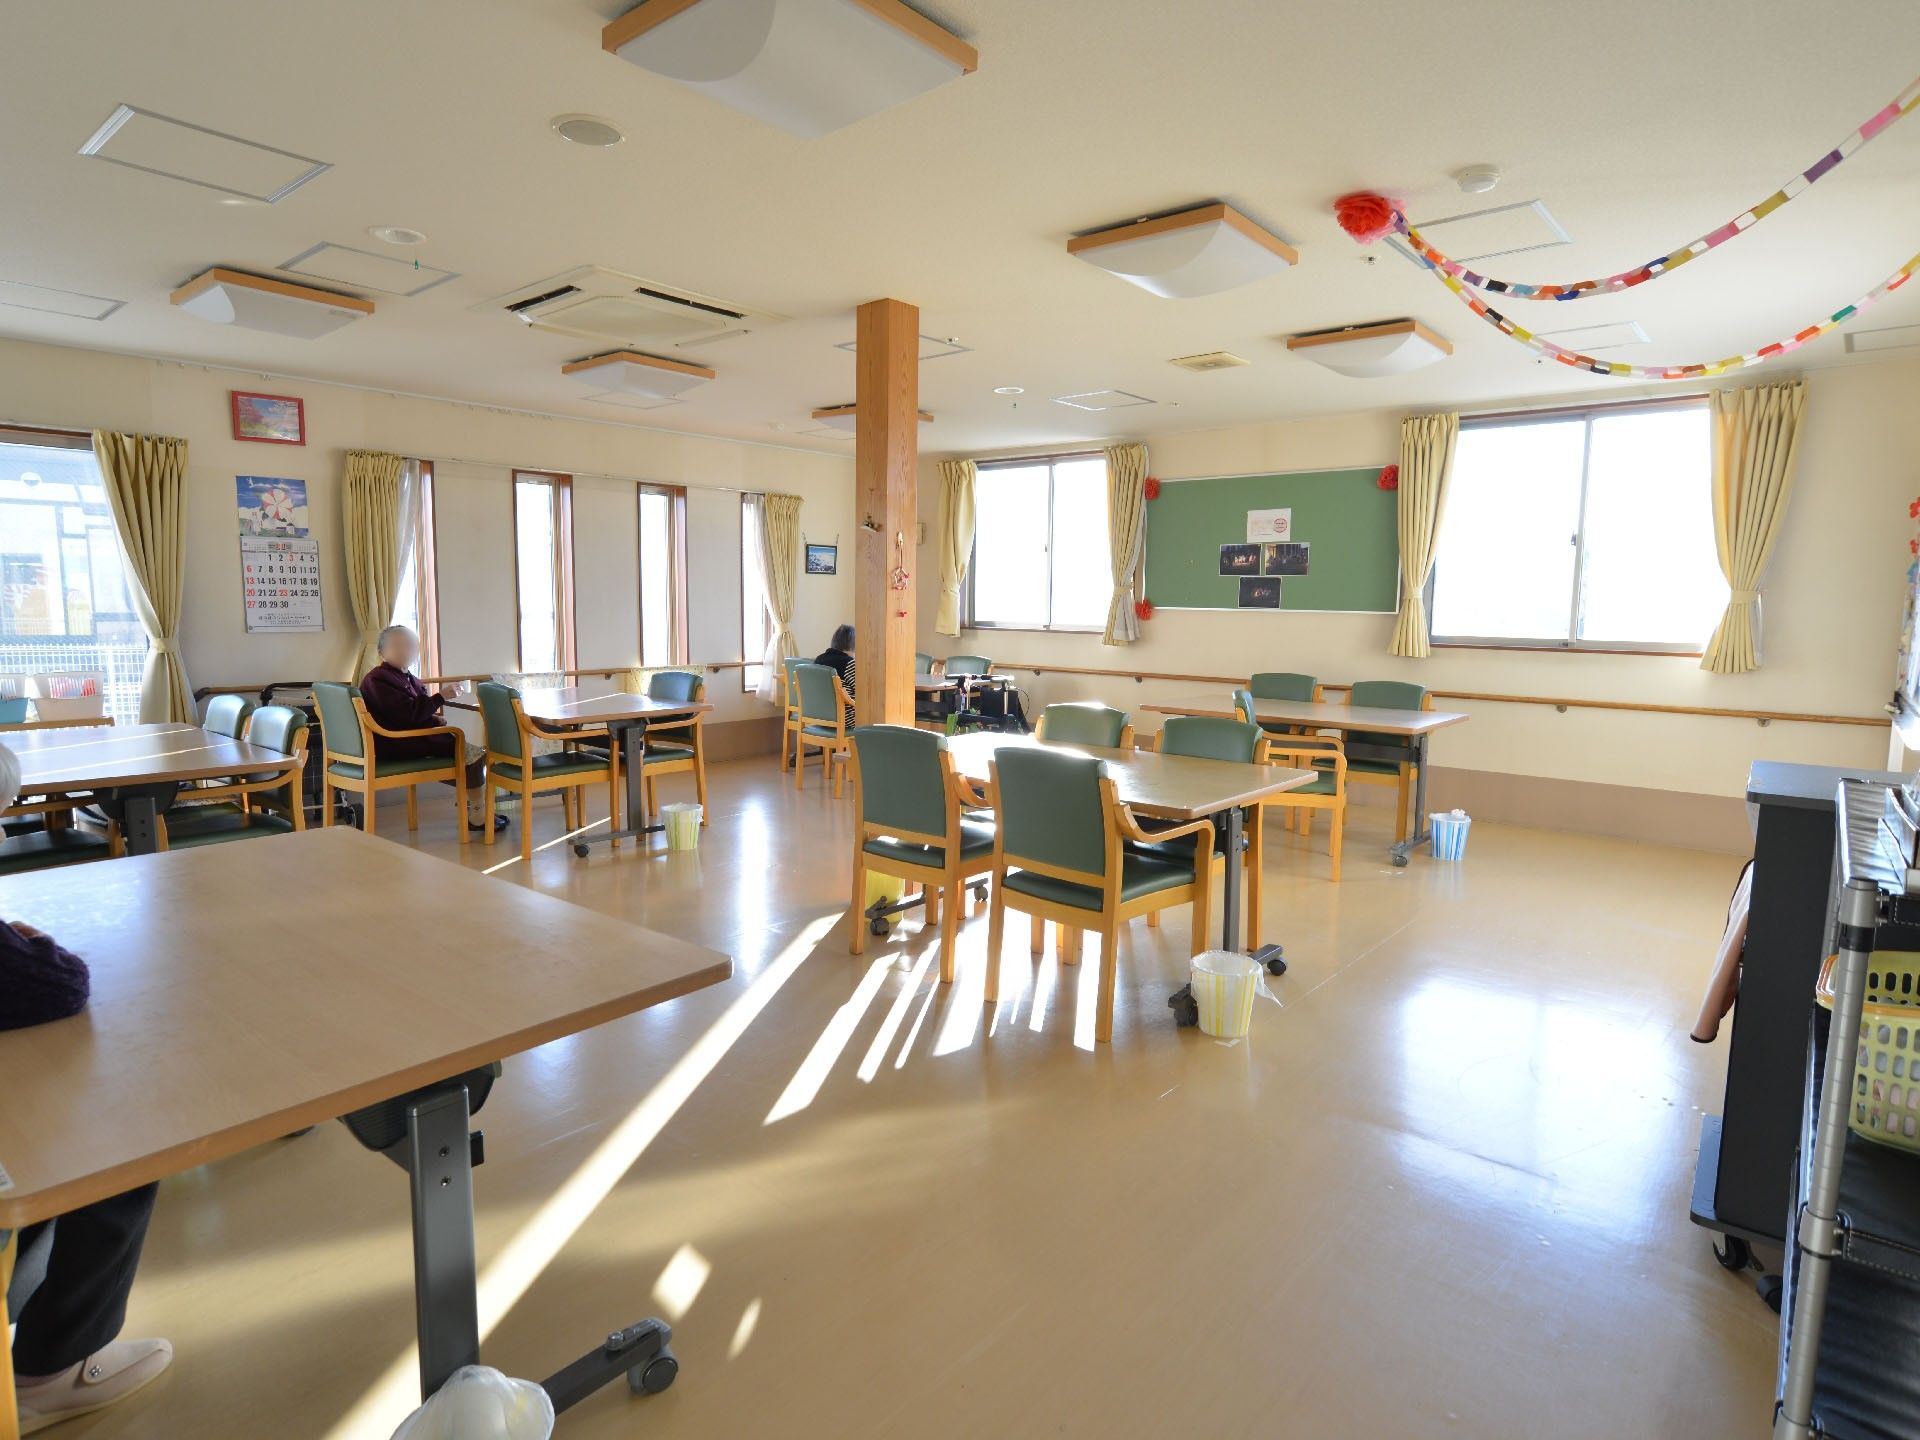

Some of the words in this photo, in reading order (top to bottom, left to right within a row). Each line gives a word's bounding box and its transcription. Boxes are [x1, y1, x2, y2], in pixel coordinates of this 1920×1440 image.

[289, 554, 294, 562] 3
[246, 565, 252, 573] 6
[257, 565, 263, 573] 7
[268, 565, 274, 573] 8
[279, 565, 284, 573] 9
[288, 566, 297, 574] 10
[300, 566, 307, 574] 11
[309, 566, 317, 574] 12
[246, 576, 255, 585] 13
[257, 577, 265, 585] 14
[268, 577, 277, 585] 15
[278, 577, 287, 585] 16
[289, 577, 297, 585] 17
[300, 577, 308, 586] 18
[310, 578, 318, 586] 19
[246, 589, 256, 597] 20
[257, 589, 266, 597] 21
[268, 589, 277, 597] 22
[279, 589, 288, 597] 23
[289, 589, 298, 597] 24
[300, 589, 309, 597] 25
[310, 589, 319, 597] 26
[247, 600, 256, 608] 27
[258, 601, 267, 609] 28
[269, 601, 278, 609] 29
[279, 600, 289, 609] 30
